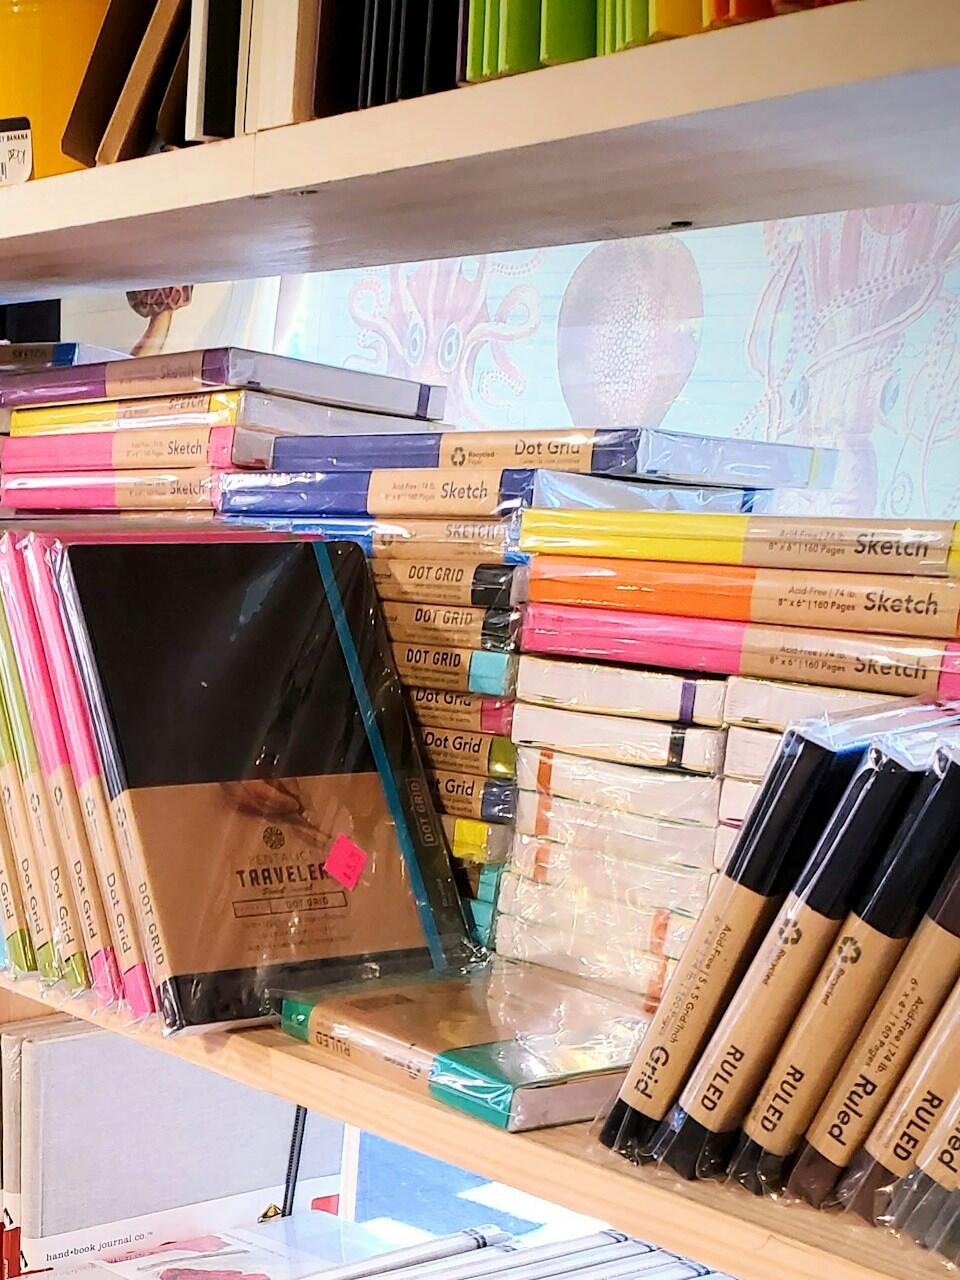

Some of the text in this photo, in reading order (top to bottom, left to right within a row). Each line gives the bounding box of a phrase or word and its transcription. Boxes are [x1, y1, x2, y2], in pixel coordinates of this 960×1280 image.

[6, 132, 29, 143] BANANA
[12, 350, 46, 360] SKETCH
[167, 439, 202, 455] Sketch
[468, 450, 495, 459] Recycled
[514, 440, 542, 456] Dot
[170, 481, 205, 496] Sketch
[442, 481, 488, 500] Sketch
[803, 543, 845, 557] 160 Pages
[854, 533, 929, 558] Sketch
[408, 565, 464, 583] DOT GRID
[788, 585, 828, 597] Acid-Free
[813, 600, 829, 610] 160
[830, 601, 856, 614] Pages
[864, 591, 939, 615] Sketch
[415, 607, 473, 626] DOT GRID
[406, 648, 461, 668] DOT GRID
[804, 658, 846, 673] 160 Pages
[854, 655, 928, 680] Sketch
[416, 686, 440, 703] Dot
[425, 731, 481, 754] Dot Grid
[445, 779, 475, 797] Grid
[0, 882, 14, 921] Grid
[21, 858, 44, 936] Dot Grid
[50, 866, 75, 946] Dot Grid
[73, 860, 97, 940] Dot Grid
[306, 897, 329, 907] GRID
[106, 872, 132, 954] Dot Grid
[138, 881, 166, 967] DOT GRID
[704, 923, 732, 971] Acid-Free
[669, 1001, 696, 1044] Grid/Inch
[884, 995, 925, 1064] Acid-Free 74
[315, 1030, 351, 1058] RULED
[865, 1020, 897, 1068] 160 Pages
[634, 1045, 670, 1101] Grid
[700, 1043, 745, 1112] RULED
[760, 1064, 805, 1133] RULED
[827, 1073, 878, 1147] Ruled
[893, 1089, 944, 1163] RULED
[98, 1234, 132, 1251] journal
